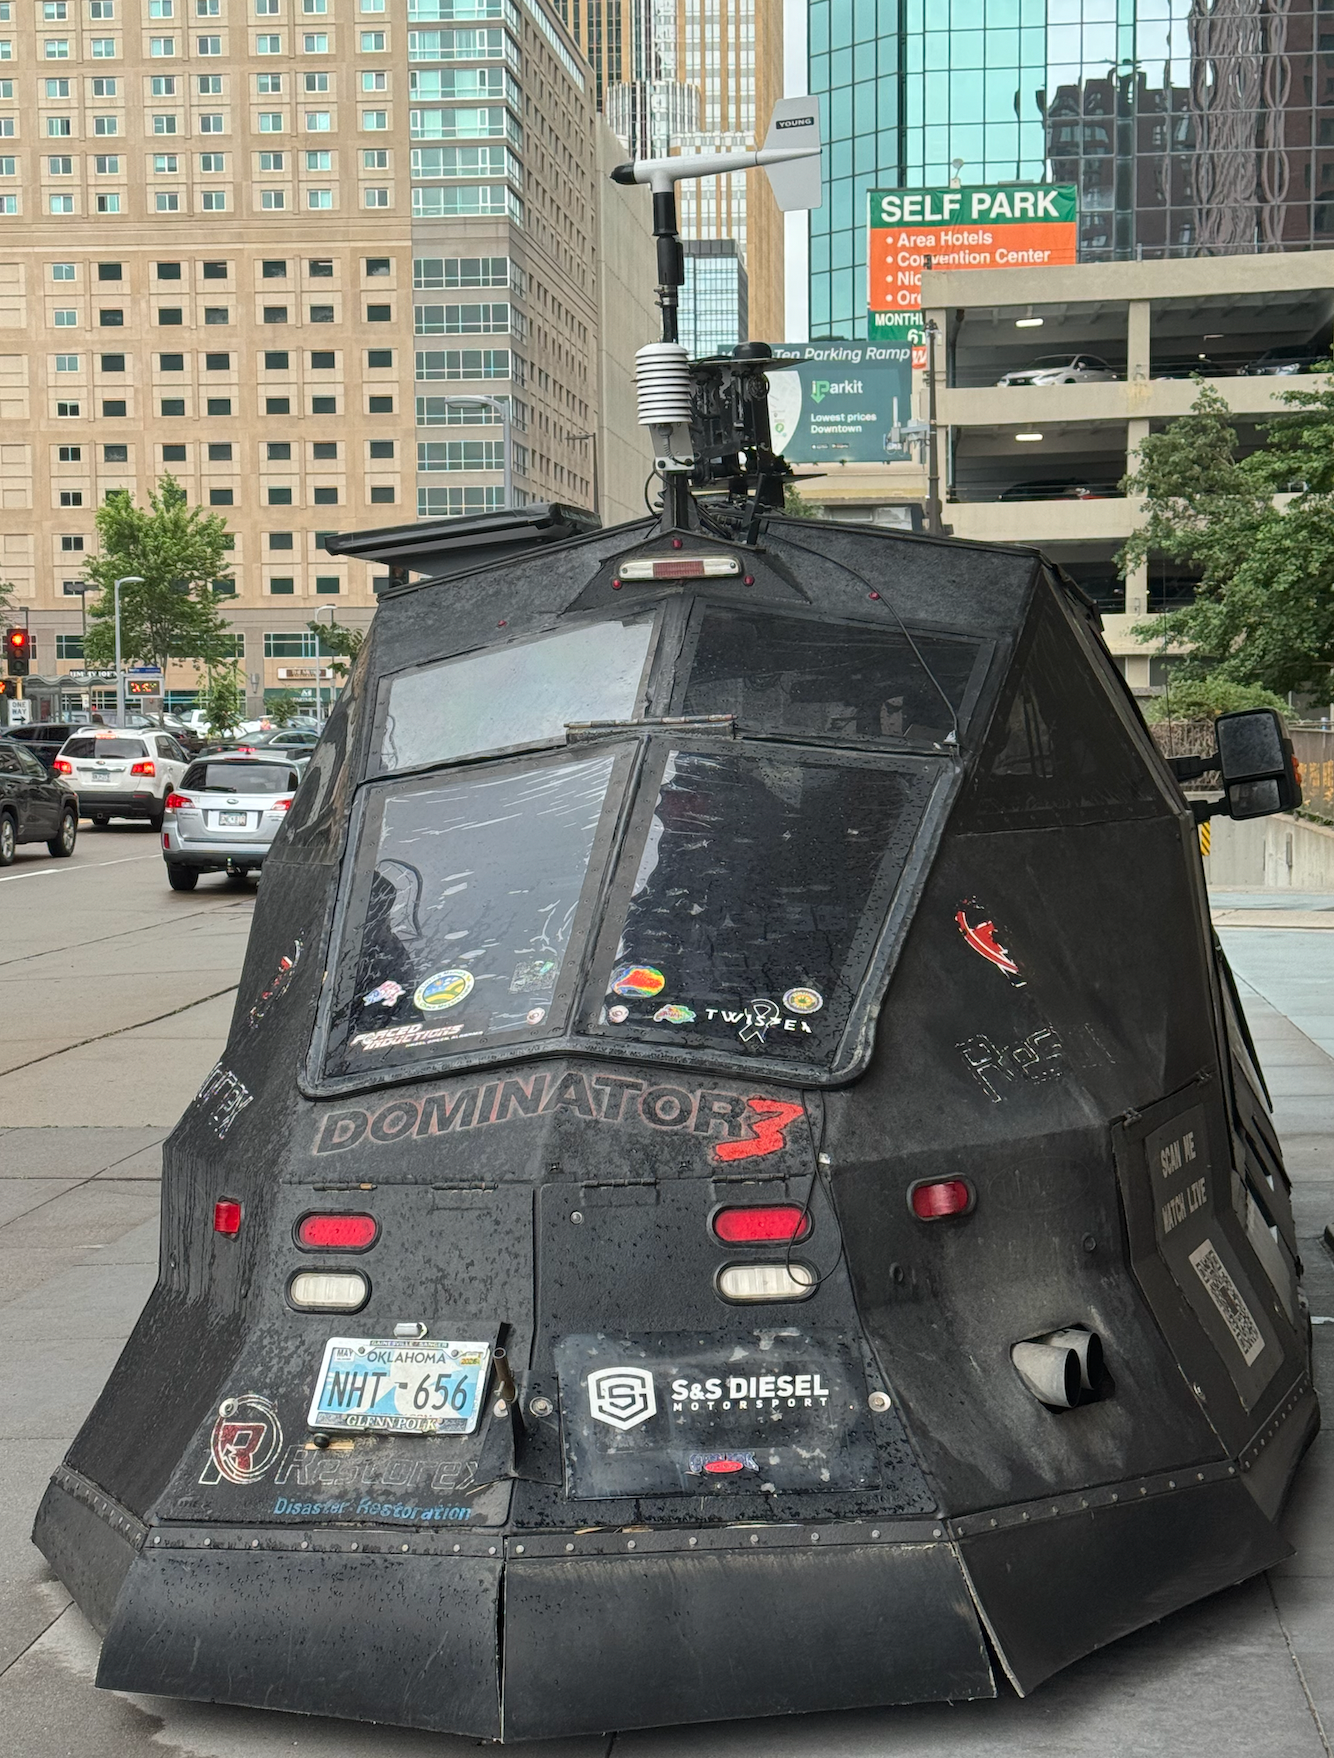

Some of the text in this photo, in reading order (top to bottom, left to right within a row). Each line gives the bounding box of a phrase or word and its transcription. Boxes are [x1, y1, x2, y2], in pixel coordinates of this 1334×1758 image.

[779, 118, 811, 128] YOUNG
[880, 190, 1060, 222] SELF PARK
[897, 230, 993, 247] Area Hotels
[995, 248, 1051, 264] Center
[875, 313, 924, 326] MONTHL
[805, 347, 862, 363] Parking
[866, 347, 911, 362] Ramp
[811, 380, 863, 403] iParkit
[811, 412, 878, 423] Lowest prices
[811, 424, 862, 434] Downtown
[314, 1072, 754, 1156] DOMINATOR
[713, 1095, 804, 1161] 3
[1161, 1131, 1197, 1179] SCAN ME
[1162, 1177, 1207, 1234] WATCH LIVE
[367, 1351, 446, 1365] OKLAHOMA
[327, 1371, 469, 1412] NHT 656
[671, 1374, 829, 1401] S&S DIESEL
[672, 1396, 830, 1412] MOTORSPORT
[346, 1415, 437, 1431] GLENN POLK
[273, 1497, 471, 1521] Disaster Restoration
